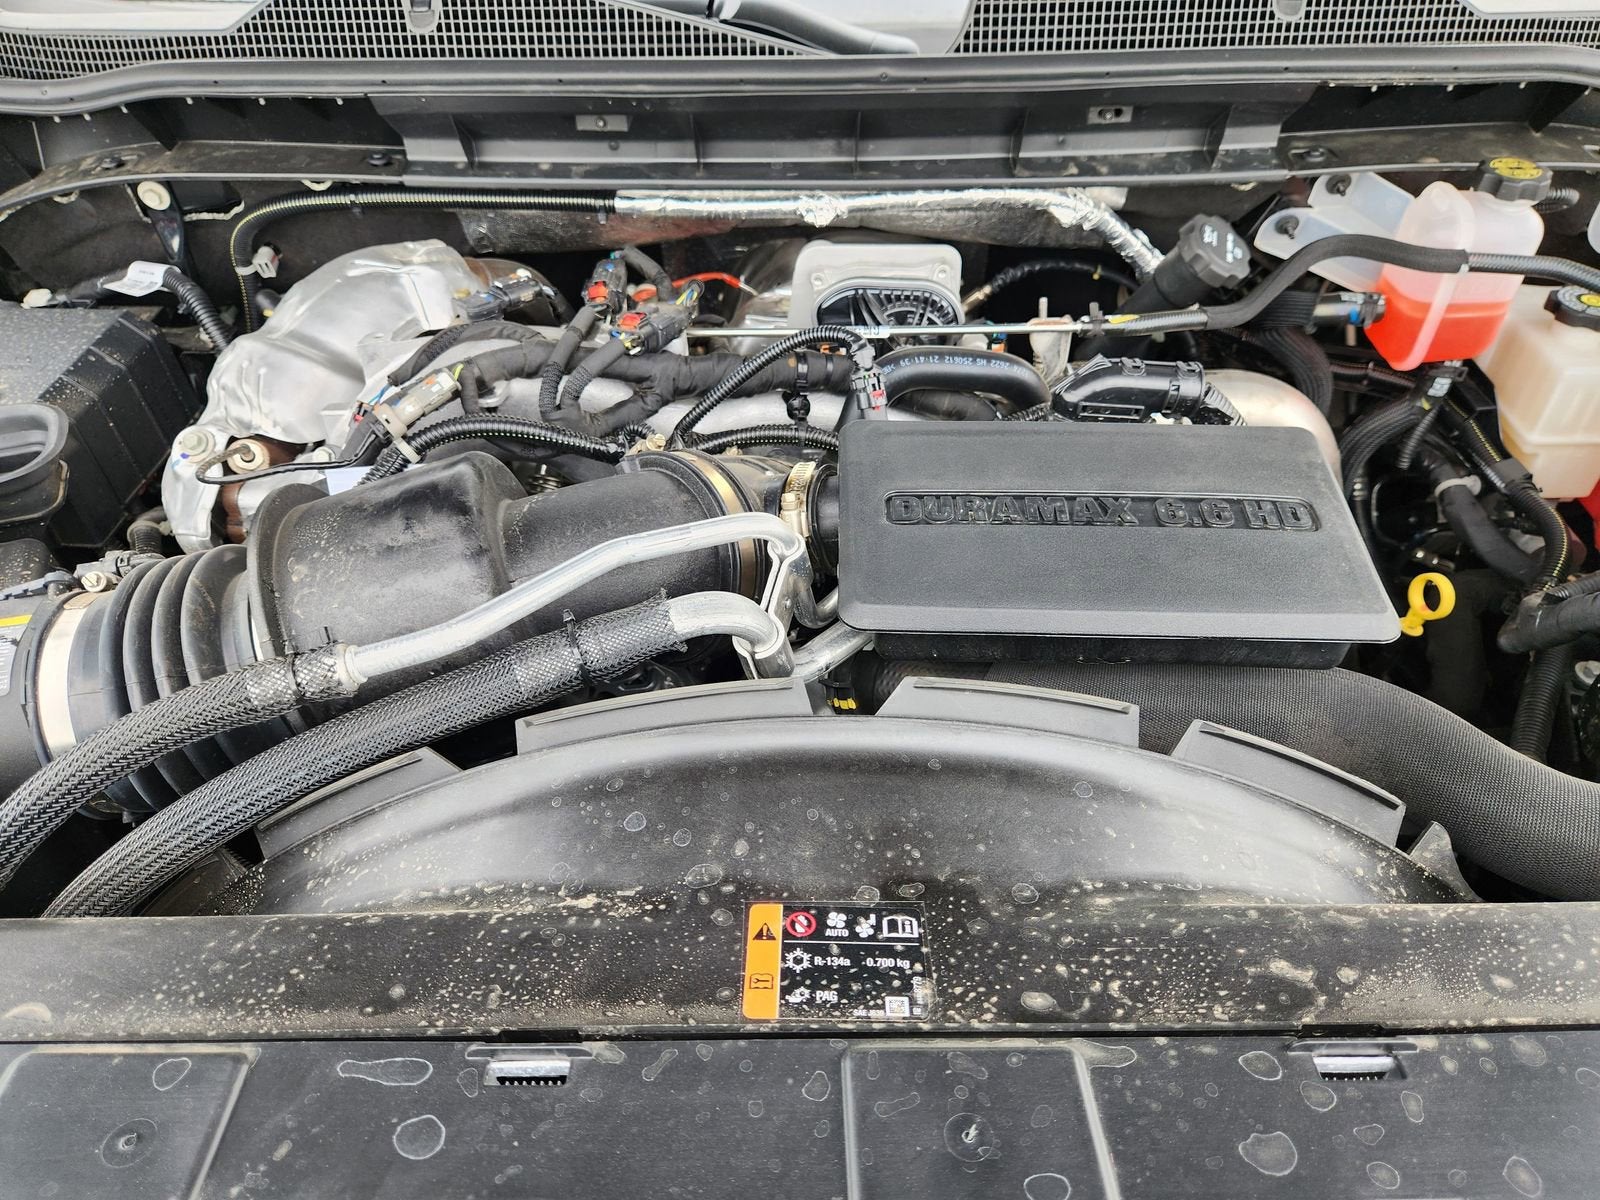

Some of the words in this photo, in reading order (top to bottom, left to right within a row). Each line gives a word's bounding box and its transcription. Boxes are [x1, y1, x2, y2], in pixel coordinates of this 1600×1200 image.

[891, 495, 1139, 526] DURAMAX
[1154, 499, 1235, 529] 6.6
[1243, 499, 1313, 531] HD
[825, 929, 849, 937] AUTO
[814, 957, 850, 966] R-134a
[866, 957, 895, 967] 0.700
[896, 958, 911, 969] kg
[815, 991, 838, 1001] PAG
